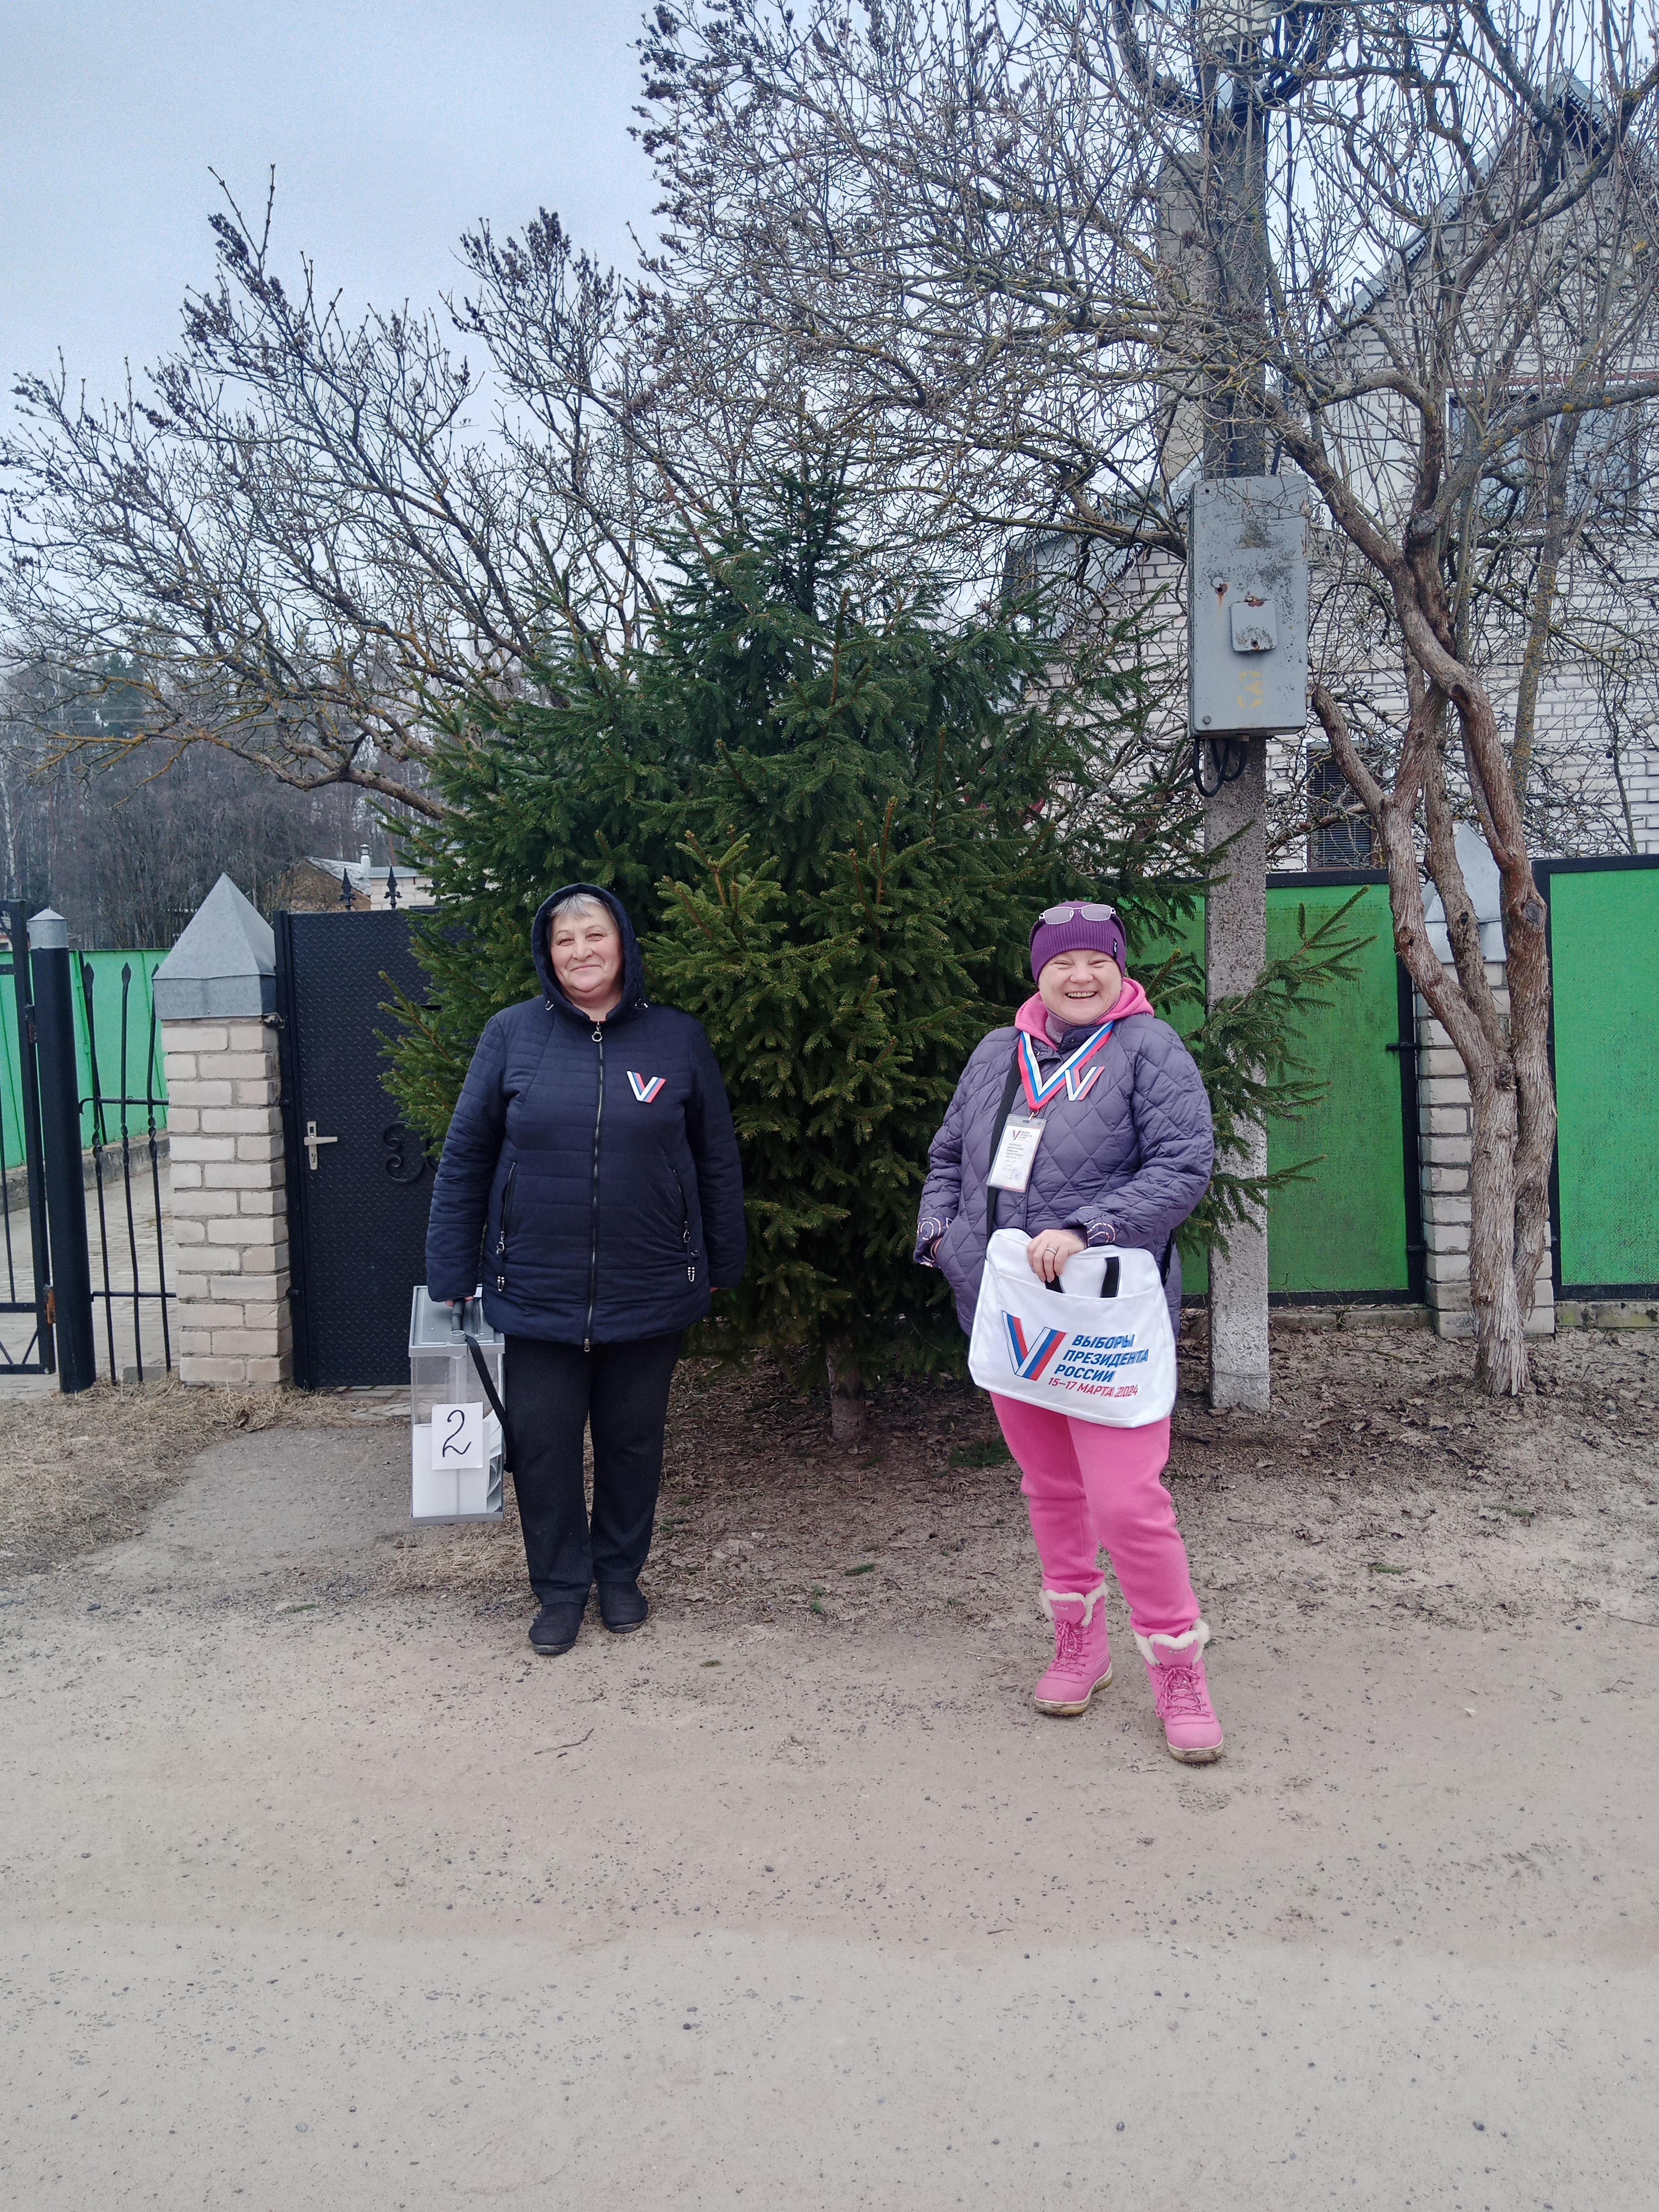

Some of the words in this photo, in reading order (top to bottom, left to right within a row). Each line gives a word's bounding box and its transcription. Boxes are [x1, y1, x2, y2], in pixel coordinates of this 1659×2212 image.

[1071, 1334, 1135, 1349] ВЫБОРЫ
[1062, 1348, 1149, 1368] ПРЕЗИДЕНТА
[1054, 1364, 1117, 1382] РОССИИ
[1077, 1383, 1114, 1397] МАРТА
[1113, 1384, 1139, 1398] 2024
[442, 1409, 472, 1457] 2
